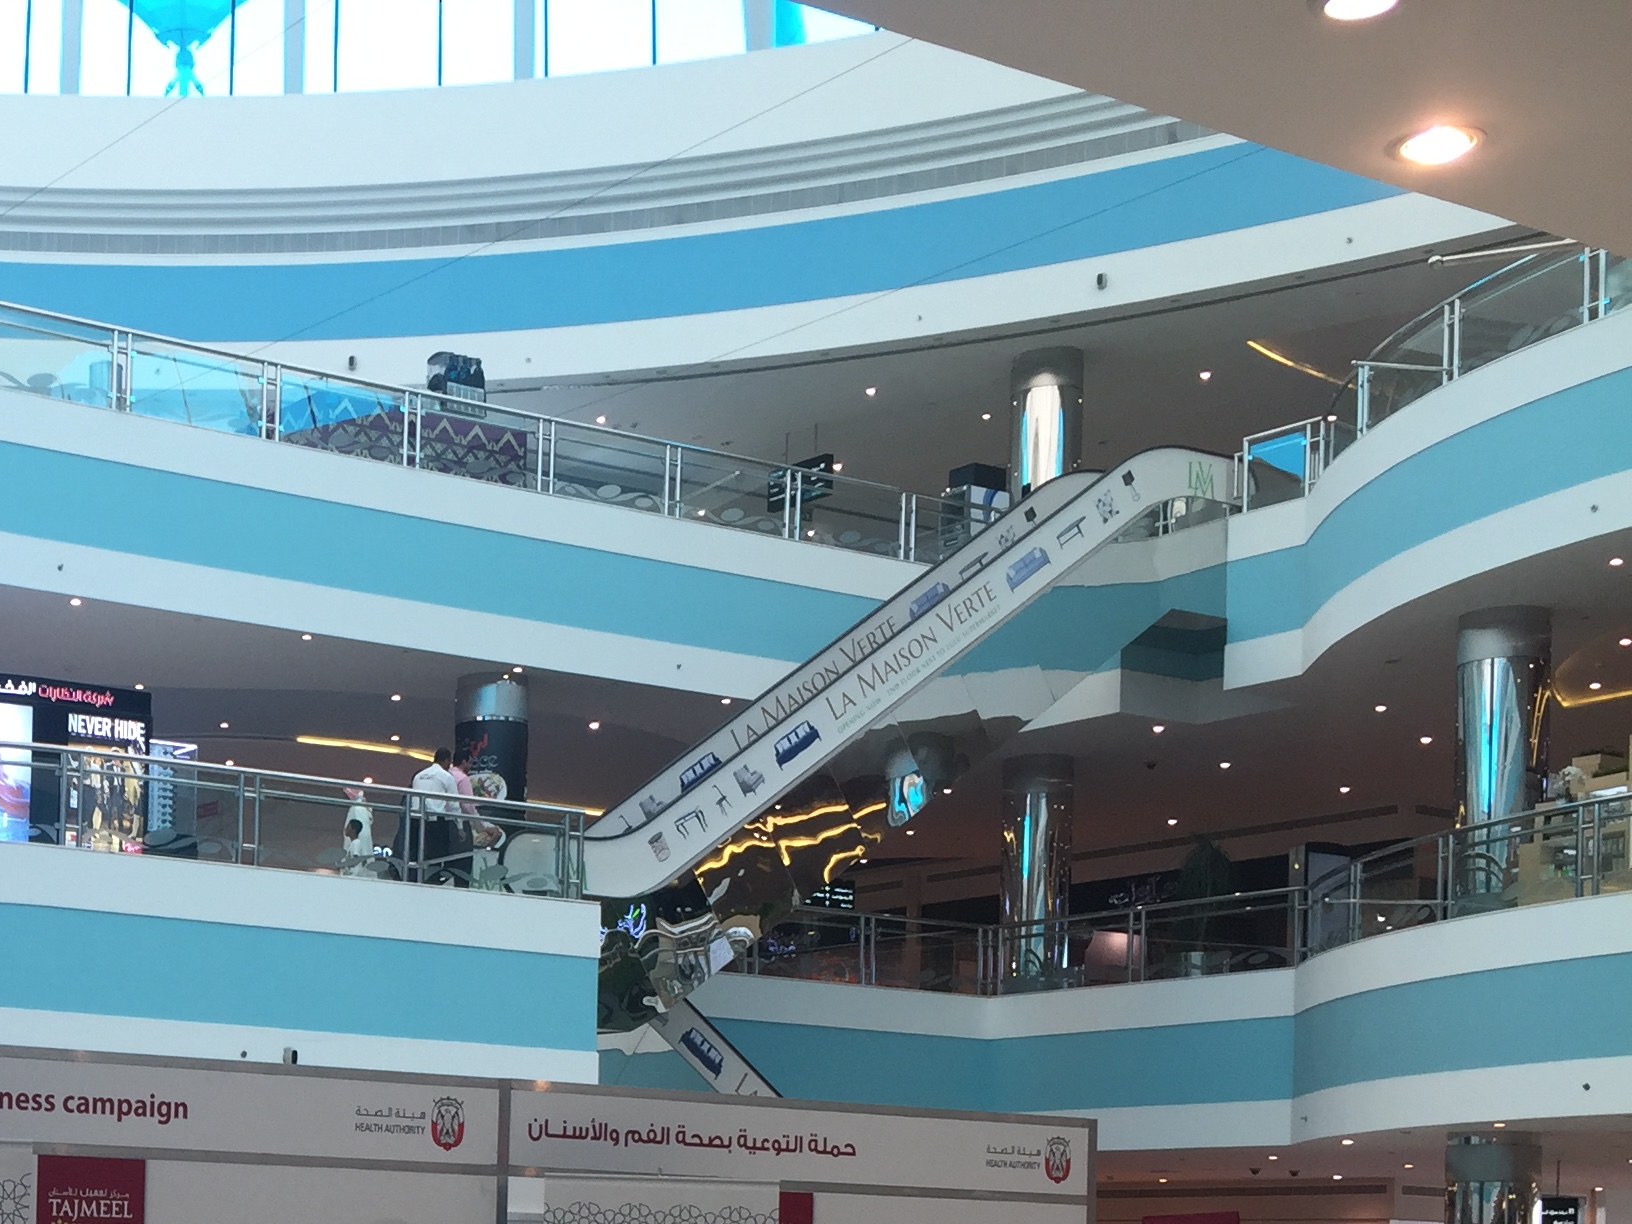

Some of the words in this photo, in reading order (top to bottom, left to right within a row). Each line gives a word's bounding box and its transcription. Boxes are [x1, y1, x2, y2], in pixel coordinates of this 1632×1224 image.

[825, 692, 857, 721] LA
[857, 626, 939, 699] MAISON
[935, 581, 997, 632] VERTE
[730, 724, 760, 750] LA
[760, 660, 840, 730] MAISON
[839, 616, 898, 664] VERTE
[68, 713, 112, 737] NEVER
[114, 718, 146, 741] HIDE
[837, 711, 867, 735] OPENING
[62, 1093, 189, 1126] campaign
[355, 1105, 393, 1118] الصحة
[395, 1108, 426, 1122] هيئة
[355, 1123, 383, 1133] HEALTH
[384, 1124, 426, 1135] AUTHORITY
[624, 1123, 670, 1147] الفم
[675, 1124, 732, 1154] بصحة
[736, 1128, 803, 1157] التوعية
[807, 1131, 857, 1158] حملة
[986, 1159, 1008, 1169] HEALTH
[1008, 1160, 1041, 1170] AUTHORITY
[48, 1198, 133, 1222] TAJMEEL
